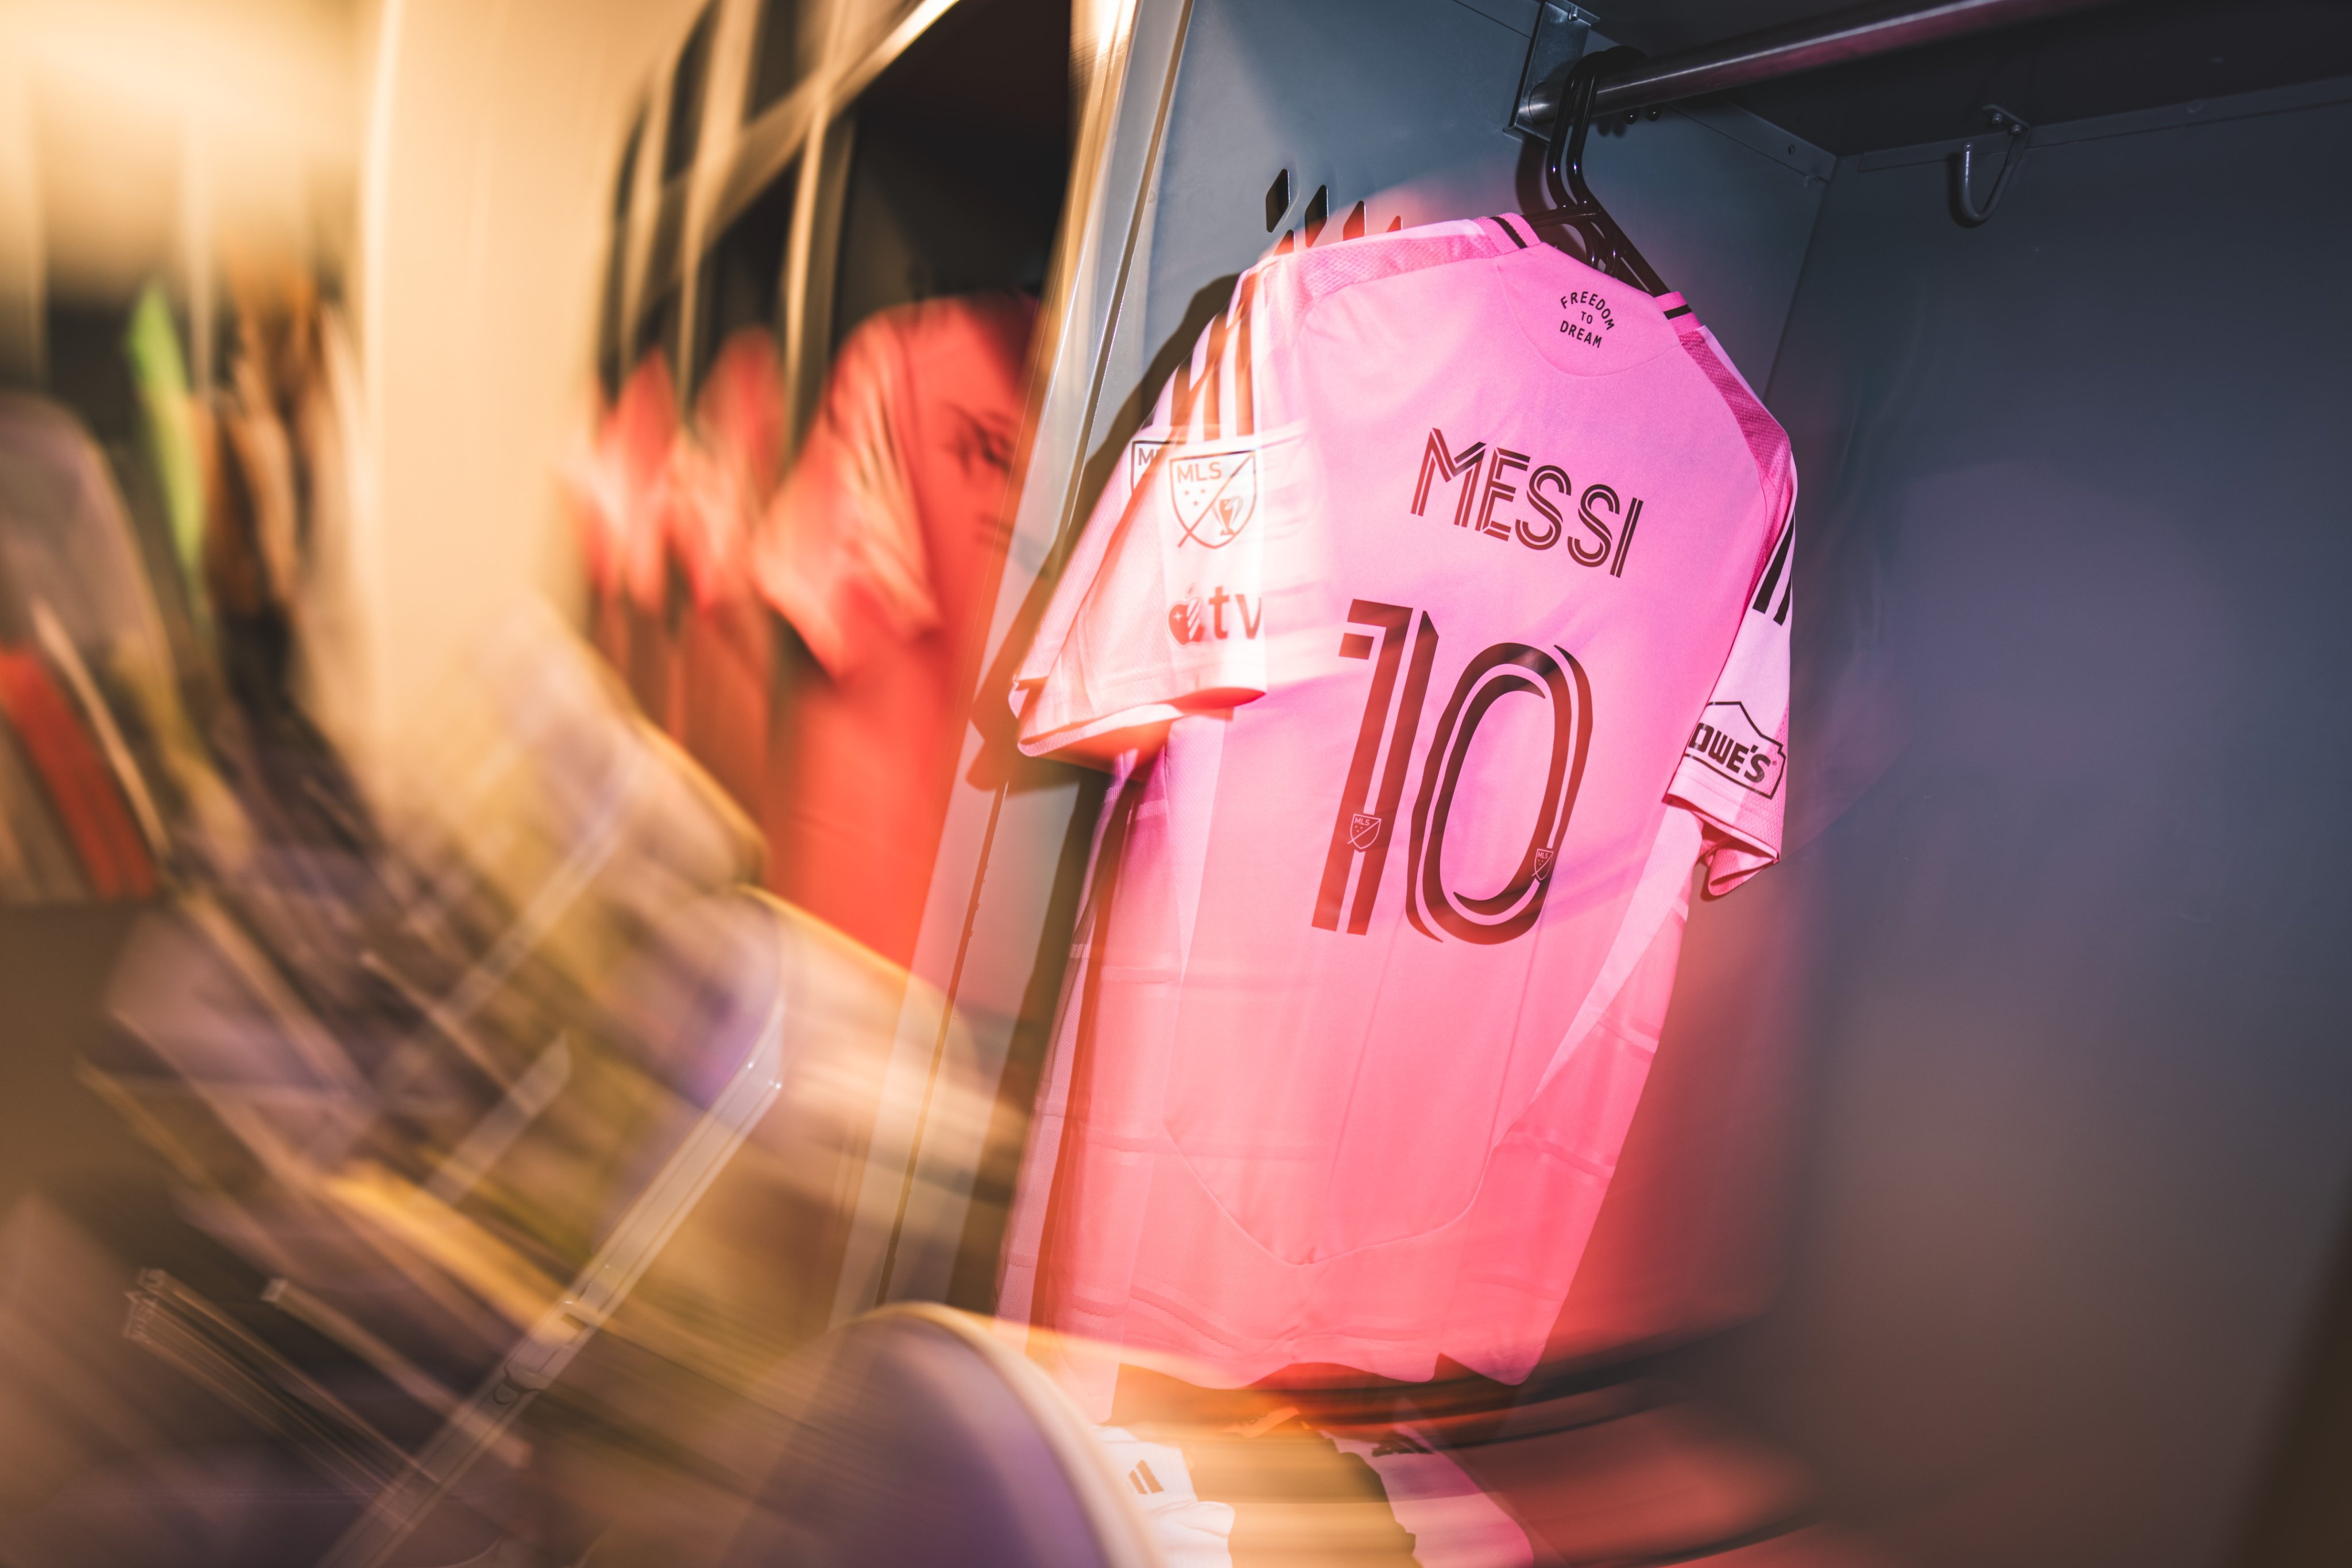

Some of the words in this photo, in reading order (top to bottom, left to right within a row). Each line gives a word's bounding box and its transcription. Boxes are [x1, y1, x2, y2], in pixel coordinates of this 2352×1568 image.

[1560, 291, 1615, 330] FREEDOM
[1581, 311, 1593, 324] TO
[1560, 320, 1602, 348] DREAM
[1177, 462, 1222, 483] MLS
[1410, 427, 1644, 578] MESSI
[1688, 722, 1771, 783] OWE'S
[1311, 598, 1593, 946] 10
[1354, 817, 1370, 826] MLS
[1537, 851, 1549, 860] MLS
